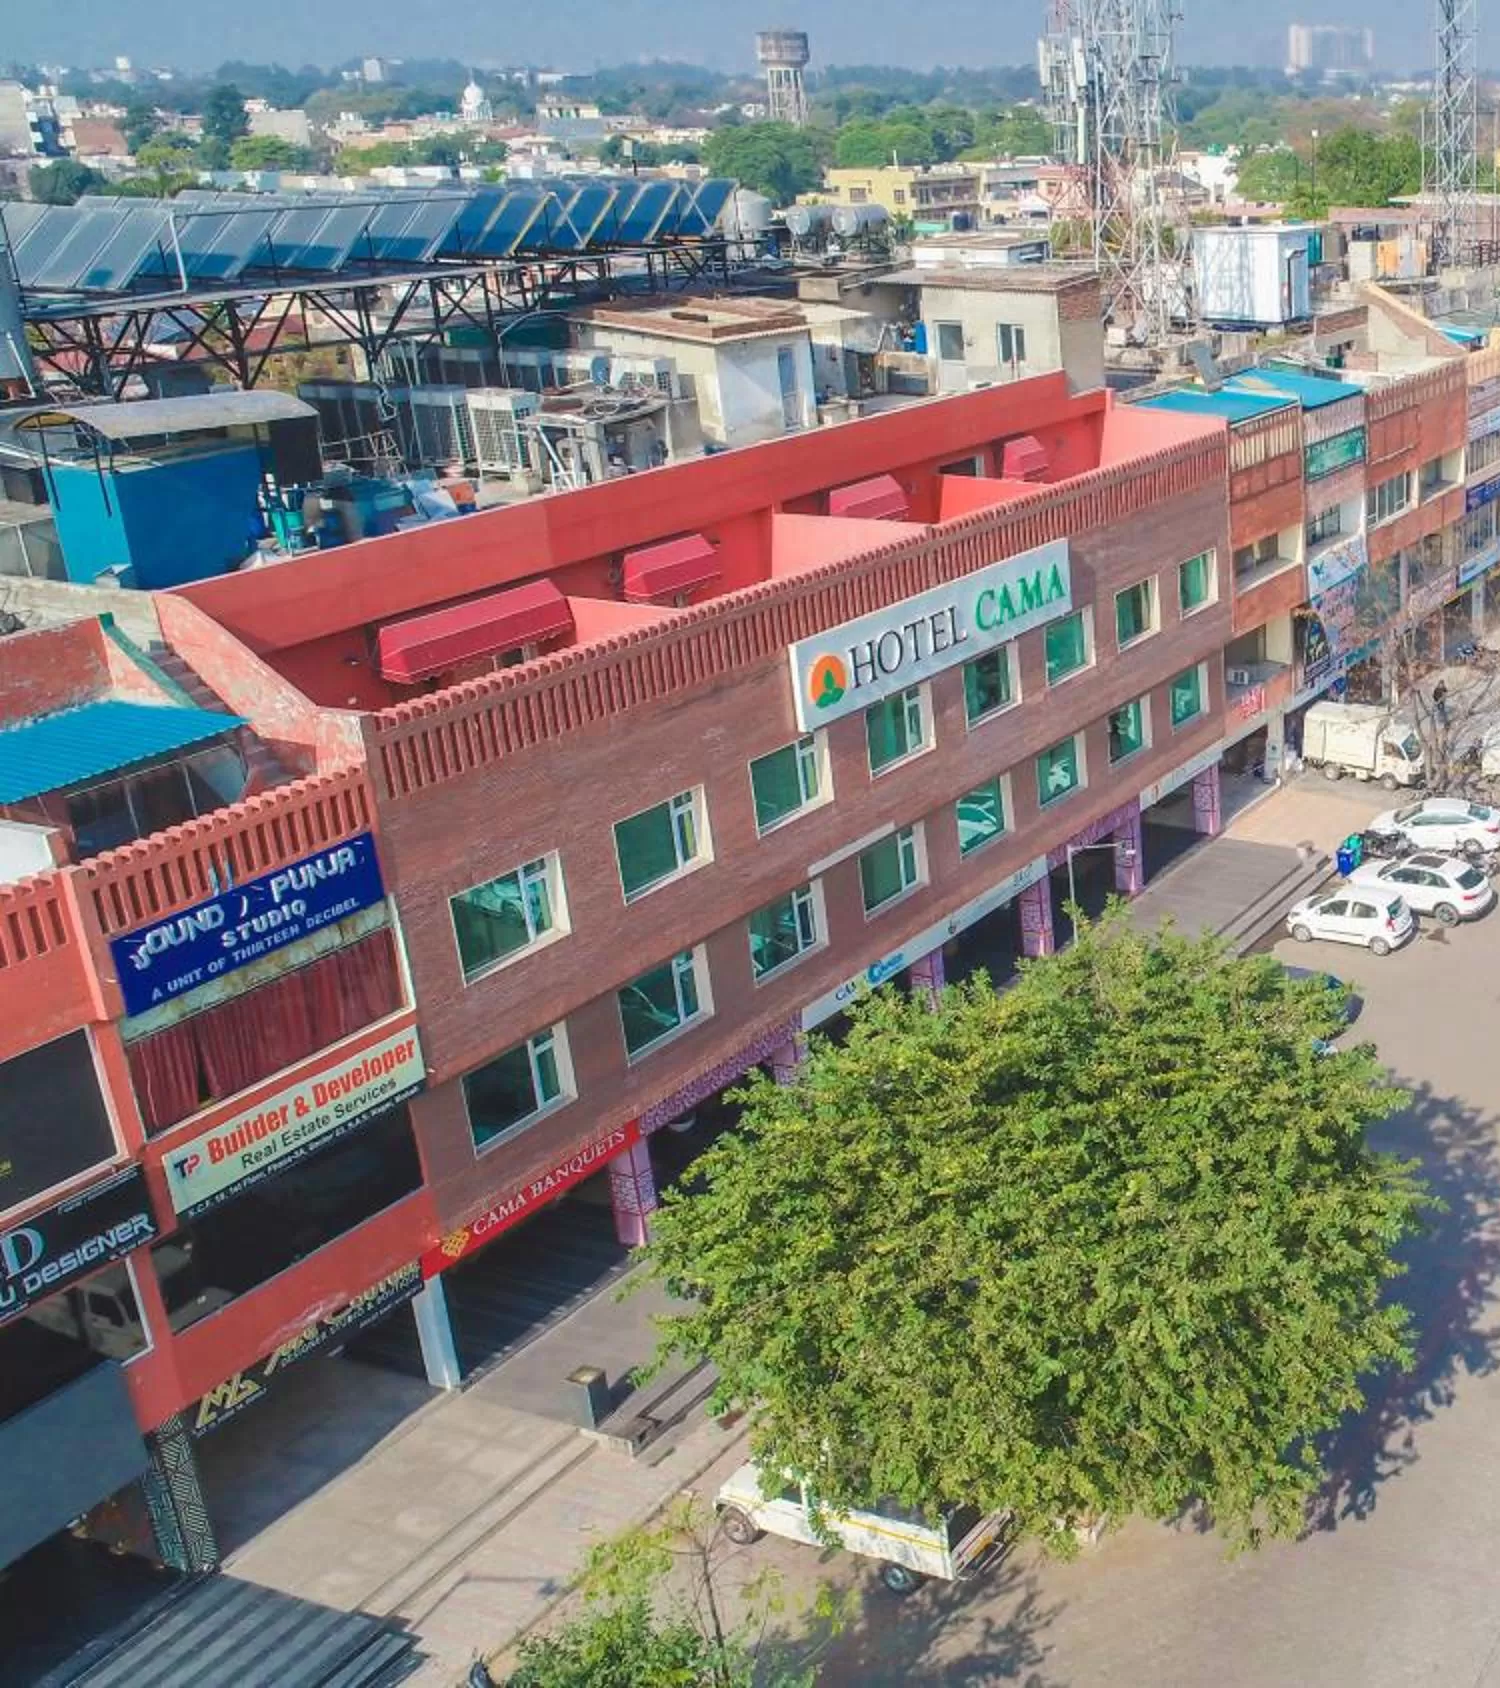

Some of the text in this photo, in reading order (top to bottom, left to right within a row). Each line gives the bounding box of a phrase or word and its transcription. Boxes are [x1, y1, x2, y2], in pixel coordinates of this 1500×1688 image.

[847, 563, 1067, 690] HOTEL CAMA
[129, 903, 225, 971] SOUND
[269, 839, 365, 903] PUNJA
[151, 897, 361, 1001] A UNIT OF THIRTEEN DECIBEL
[222, 899, 307, 949] STUDIO
[206, 1104, 289, 1165] Builder
[293, 1096, 312, 1119] &
[311, 1038, 416, 1110] Developer
[240, 1143, 278, 1170] Real
[281, 1112, 332, 1149] Estate
[335, 1076, 398, 1120] Services
[472, 1127, 626, 1236] CAMA BANQUETS
